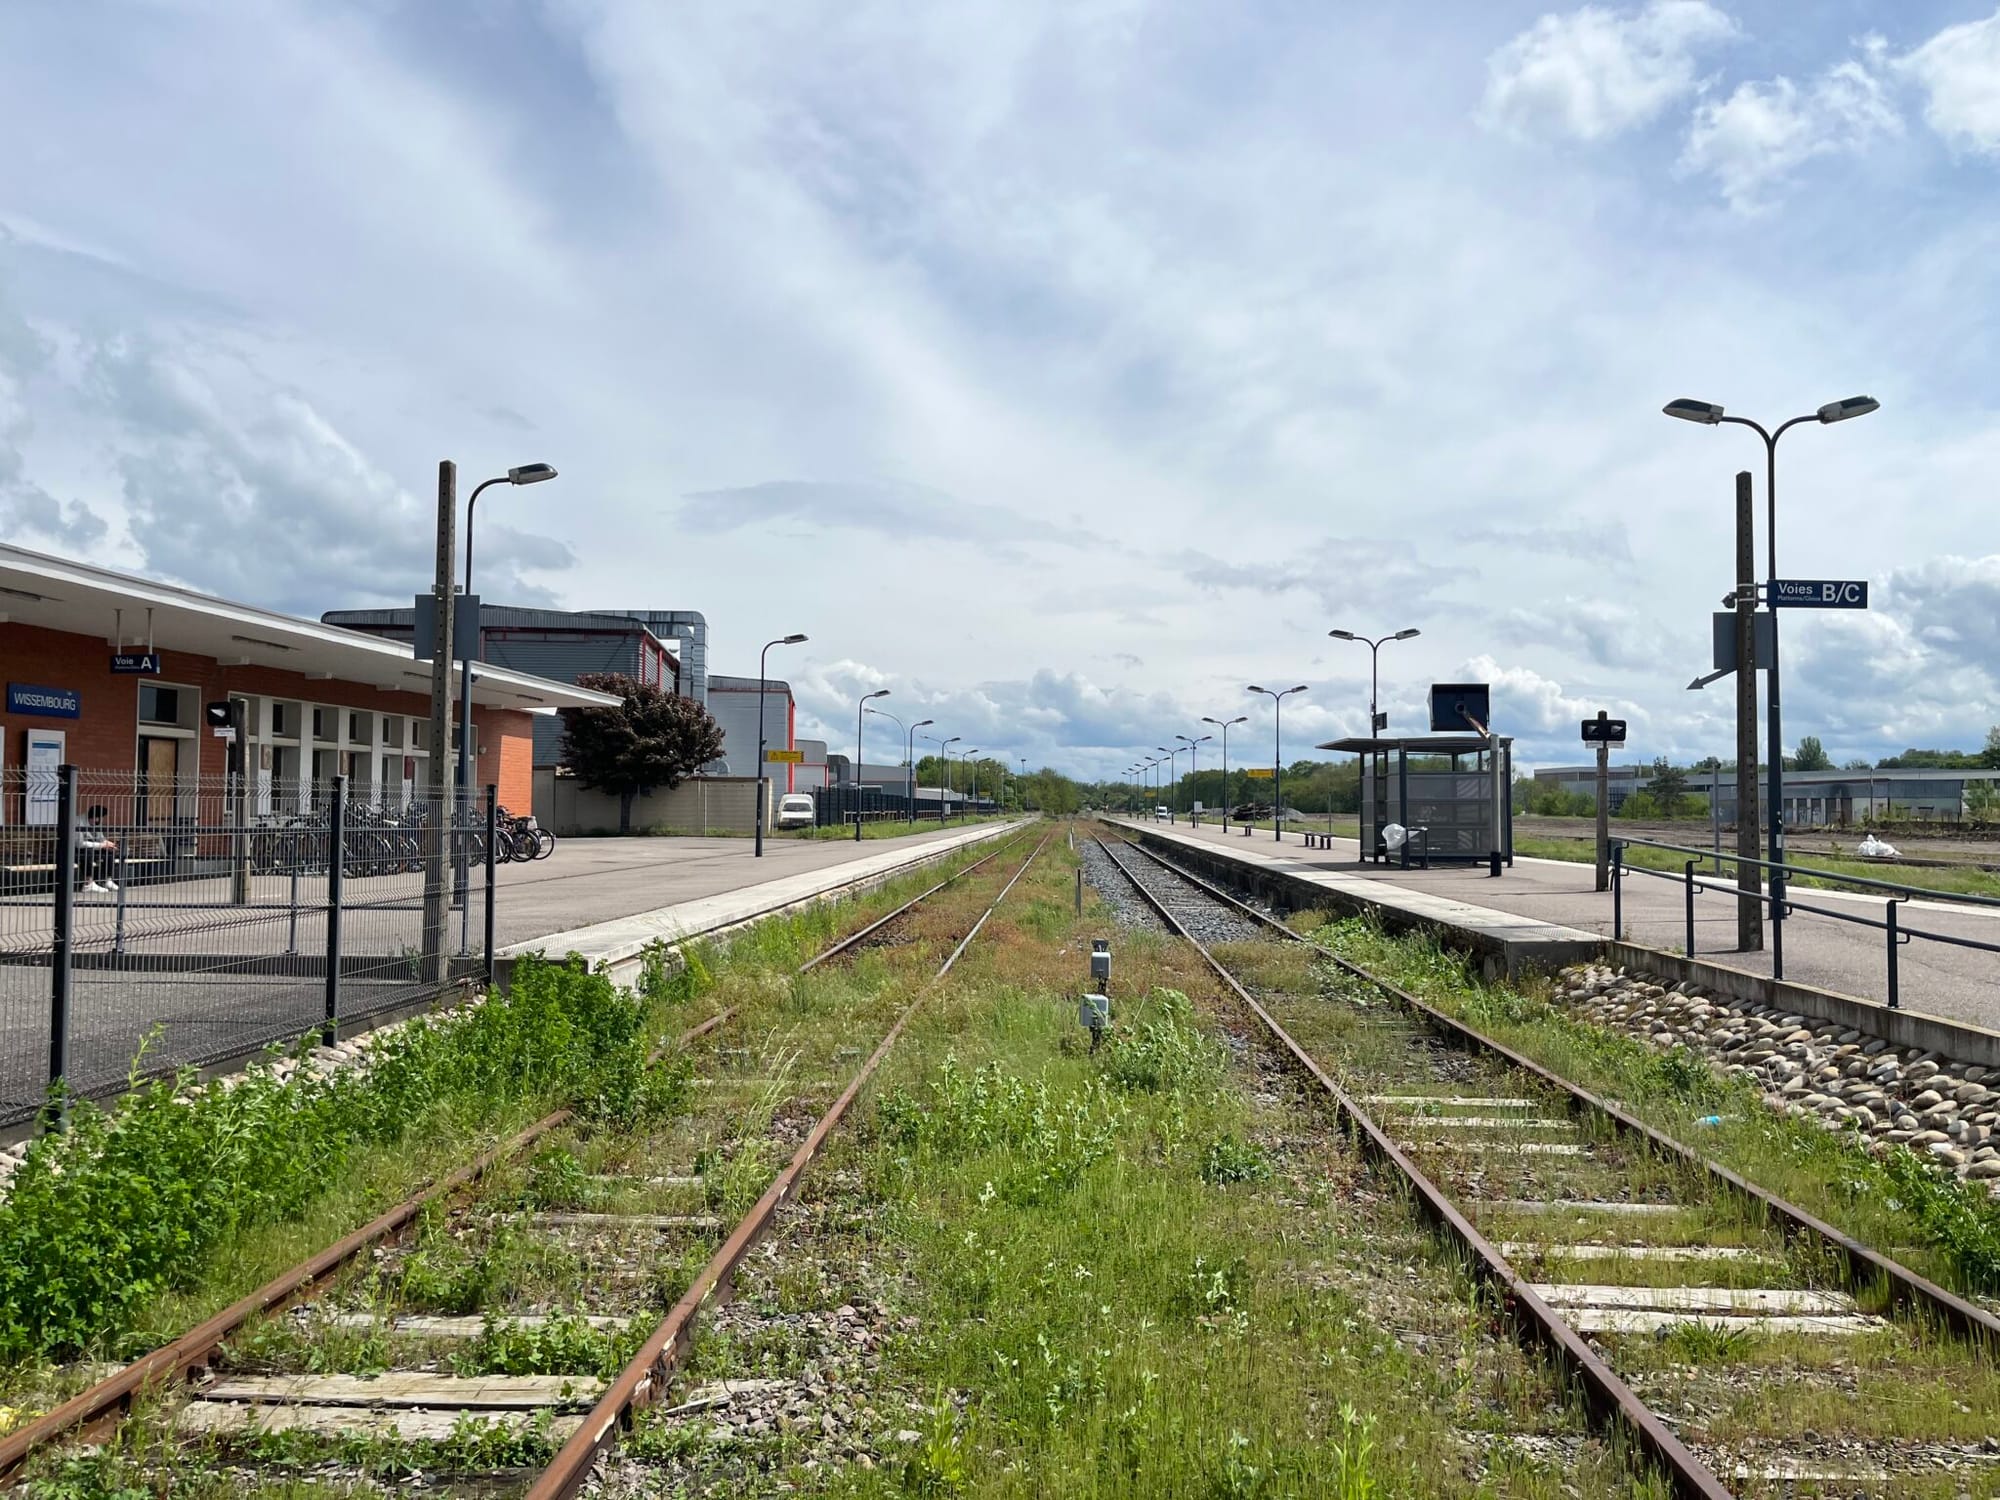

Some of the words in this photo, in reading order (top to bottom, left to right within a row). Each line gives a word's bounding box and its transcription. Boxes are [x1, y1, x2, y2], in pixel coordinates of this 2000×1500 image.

[1778, 583, 1813, 594] Voies
[1822, 582, 1860, 603] B/C
[115, 657, 134, 665] Voie
[140, 656, 152, 670] A
[14, 692, 76, 711] WISSEMBOURG
